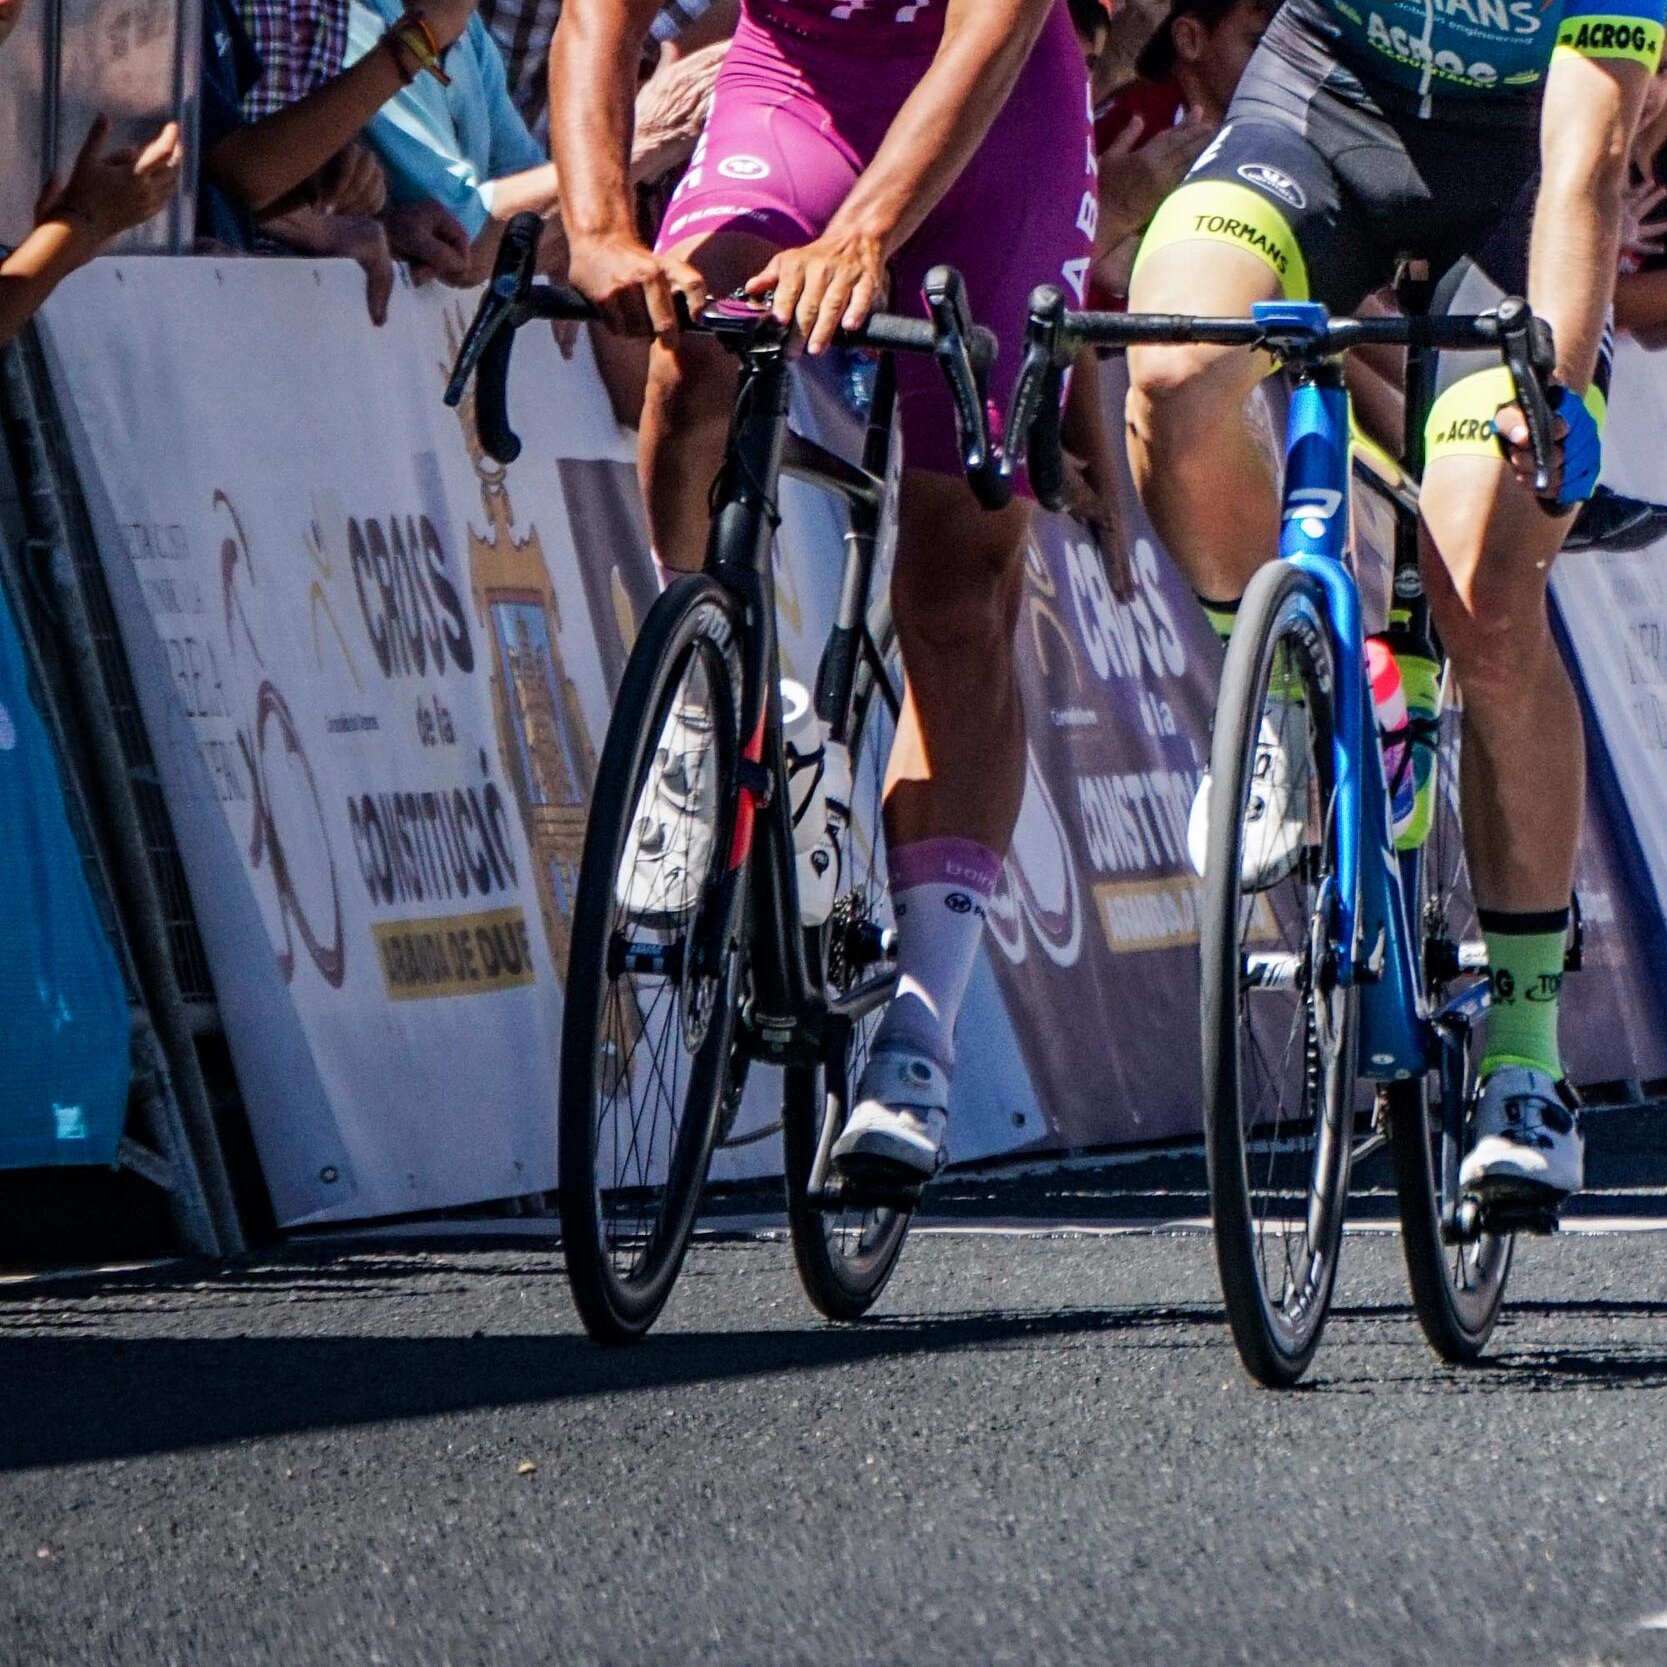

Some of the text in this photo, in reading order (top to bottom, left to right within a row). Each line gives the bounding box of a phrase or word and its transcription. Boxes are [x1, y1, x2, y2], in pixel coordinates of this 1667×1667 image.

[1574, 23, 1647, 53] ACROG
[1194, 215, 1289, 275] TORMANS
[1446, 418, 1493, 443] ACRO
[346, 747, 519, 906] CONSTITUCIÓ
